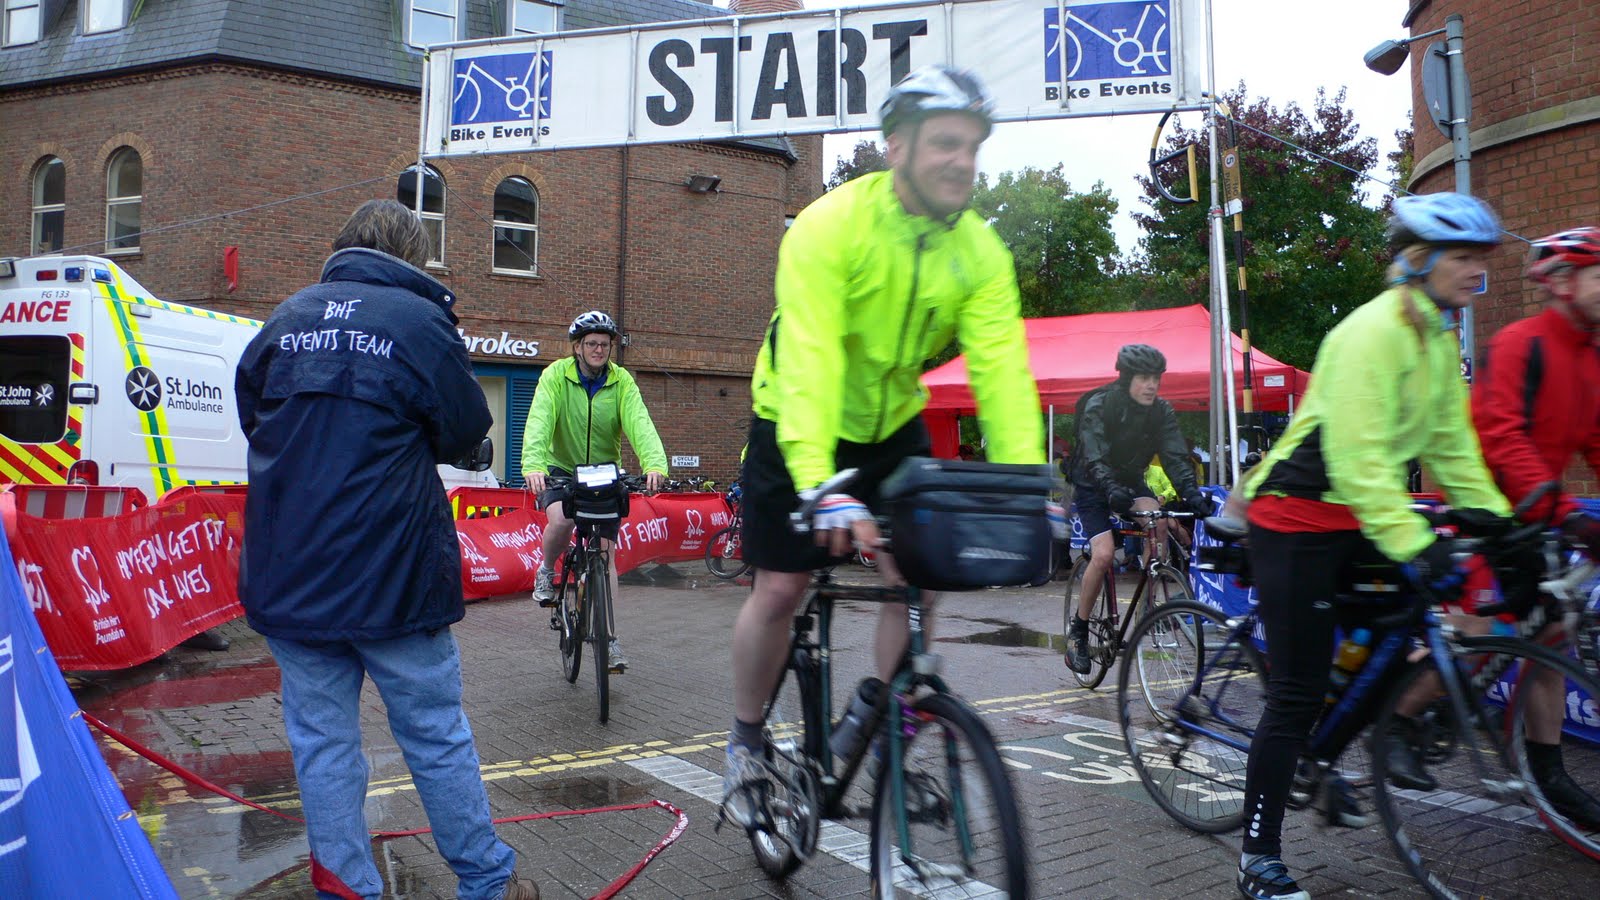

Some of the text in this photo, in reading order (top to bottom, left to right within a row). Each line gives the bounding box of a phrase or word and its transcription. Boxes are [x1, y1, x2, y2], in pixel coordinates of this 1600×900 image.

[646, 19, 927, 126] START
[1099, 81, 1171, 98] Events
[450, 127, 486, 142] Bike
[41, 290, 70, 299] FG 133
[0, 301, 71, 323] ANCE
[324, 299, 362, 320] BHF
[280, 329, 393, 359] EVENTS TEAM
[8, 385, 31, 398] John
[165, 376, 222, 400] St John
[0, 397, 30, 406] mbulance
[167, 396, 223, 414] Ambulance
[168, 521, 200, 560] GET
